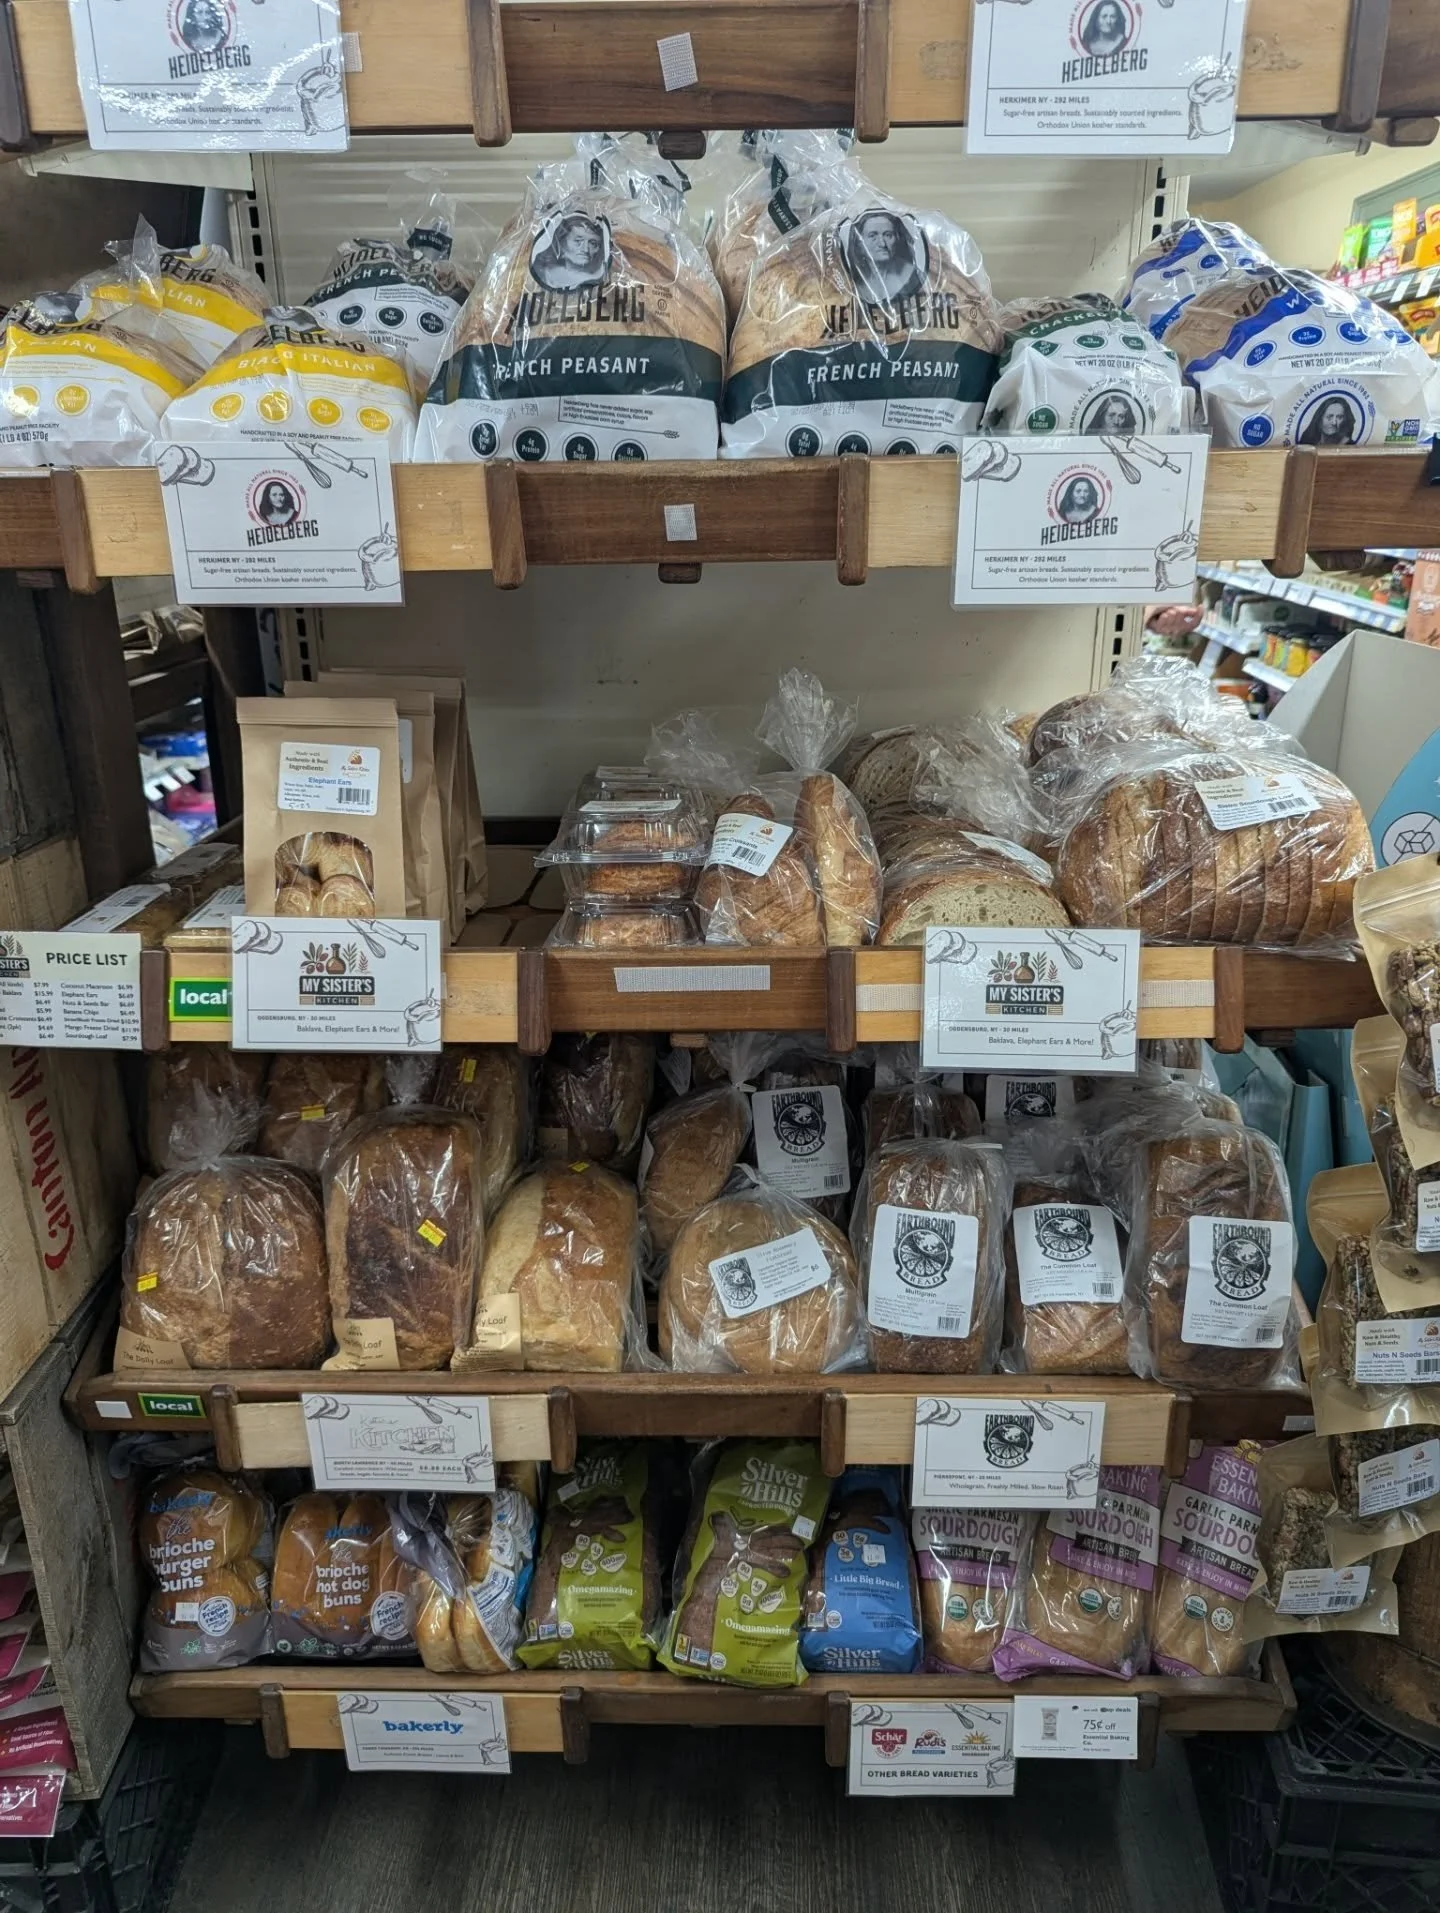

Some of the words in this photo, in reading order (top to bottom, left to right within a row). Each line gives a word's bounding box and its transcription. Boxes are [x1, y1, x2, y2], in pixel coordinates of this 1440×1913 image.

[1061, 48, 1148, 84] HEIDELBERG
[999, 96, 1036, 105] HERKIMER
[1037, 96, 1049, 105] NY
[1068, 96, 1090, 105] MILES
[1003, 109, 1036, 119] Sugar-free
[1036, 109, 1058, 118] artisan
[1083, 109, 1119, 119] Sustainably
[1119, 109, 1146, 118] sourced
[1037, 121, 1070, 130] Orthodox
[1070, 121, 1092, 130] Union
[1091, 121, 1114, 130] kosher
[1029, 309, 1109, 336] CRACKED
[303, 353, 376, 373] ITALIAN
[560, 356, 650, 375] PEASANT
[1075, 359, 1087, 368] NET
[1087, 359, 1098, 368] WT
[1098, 359, 1106, 369] 20
[1290, 360, 1305, 368] NET
[1305, 359, 1316, 367] WT
[1316, 358, 1325, 367] 20
[807, 362, 881, 385] FRENCH
[890, 360, 960, 379] PEASANT
[1069, 407, 1079, 430] MADE
[1077, 392, 1089, 408] ALL
[1285, 413, 1295, 435] MADE
[1293, 398, 1305, 412] ALL
[1304, 378, 1336, 399] NATURAL
[1337, 378, 1359, 388] SINCE
[1057, 464, 1081, 479] NATURAL
[247, 519, 319, 547] HEIDELBERG
[1040, 516, 1118, 546] HEIDELBERG
[984, 556, 1019, 564] HERKIMER
[1046, 555, 1067, 563] MILES
[272, 567, 302, 575] Sustainably
[987, 566, 1018, 575] Sugar-free
[1060, 566, 1092, 575] Sustainably
[234, 576, 263, 584] Orthodox
[263, 576, 281, 584] Union
[1018, 576, 1049, 584] Orthodox
[1049, 576, 1068, 584] Union
[288, 764, 325, 772] Ingredients
[308, 776, 337, 786] Elephant
[337, 778, 352, 786] Ears
[46, 952, 92, 966] PRICE
[96, 953, 128, 967] LIST
[302, 977, 320, 993] MY
[322, 978, 373, 994] SISTER'S
[179, 988, 228, 1006] local
[315, 996, 359, 1005] KITCHEN
[988, 986, 1008, 1002] MY
[1009, 986, 1062, 1003] SISTER'S
[1002, 1006, 1047, 1014] KITCHEN
[296, 1024, 324, 1034] Baklava,
[324, 1024, 355, 1035] Elephant
[355, 1025, 372, 1033] Ears
[372, 1025, 379, 1033] &
[379, 1025, 401, 1034] More!
[988, 1035, 1016, 1045] Baklava,
[1017, 1036, 1048, 1046] Elephant
[1048, 1036, 1065, 1045] Ears
[1065, 1037, 1072, 1046] &
[1072, 1037, 1095, 1046] More!
[1005, 1080, 1057, 1103] EARTHBOUND
[770, 1089, 825, 1118] EARTHBOUND
[786, 1140, 820, 1153] BREAD
[25, 1097, 75, 1271] Canton
[896, 1212, 957, 1242] EARTHBOUND
[1033, 1207, 1091, 1232] EARTHBOUND
[1212, 1222, 1273, 1252] EARTHBOUND
[1049, 1249, 1087, 1261] BREAD
[1052, 1262, 1082, 1270] Common
[1082, 1262, 1097, 1270] Loaf
[902, 1271, 943, 1287] BREAD
[904, 1286, 938, 1299] Multigrain
[1221, 1283, 1261, 1298] BREAD
[1208, 1299, 1222, 1307] The
[1222, 1301, 1252, 1310] Common
[1253, 1303, 1268, 1311] Loaf
[487, 1315, 508, 1326] Loaf
[363, 1339, 383, 1350] Loaf
[122, 1351, 135, 1361] The
[135, 1353, 154, 1366] Daily
[1399, 1351, 1422, 1359] Seeds
[1423, 1350, 1440, 1358] Bars
[149, 1400, 193, 1412] local
[985, 1413, 1035, 1434] EARTHBOUND
[991, 1455, 1024, 1467] BREAD
[742, 1456, 809, 1490] Silver
[754, 1482, 803, 1509] Hills
[1217, 1477, 1263, 1509] BAKIN
[967, 1507, 1019, 1525] PARMESAN
[1184, 1495, 1226, 1522] GARLIC
[165, 1515, 193, 1540] the
[919, 1516, 1022, 1548] SOURDOUGH
[1172, 1507, 1261, 1562] SOURDO
[150, 1536, 216, 1560] brioche
[1083, 1537, 1116, 1555] ARTISAN
[939, 1547, 974, 1559] ARTISAN
[976, 1550, 1001, 1561] BREAD
[1190, 1544, 1229, 1569] ARTISAN
[1229, 1560, 1257, 1580] BREAD
[316, 1563, 370, 1578] brioche
[834, 1573, 858, 1584] Little
[859, 1575, 875, 1586] Big
[875, 1576, 901, 1590] Bread
[1200, 1568, 1225, 1586] ENJOY
[1225, 1577, 1235, 1589] IN
[315, 1578, 338, 1593] hot
[341, 1577, 370, 1597] dog
[567, 1584, 634, 1597] Omegamazing
[323, 1592, 362, 1609] buns
[202, 1602, 229, 1619] French
[376, 1601, 405, 1617] French
[204, 1610, 230, 1624] recipe
[725, 1617, 791, 1636] Omegamazing
[557, 1649, 611, 1665] Silver
[822, 1648, 881, 1660] Silver
[836, 1656, 881, 1668] Hills
[383, 1720, 464, 1735] bakerly
[1082, 1719, 1104, 1730] 75¢
[1104, 1723, 1116, 1731] off
[914, 1736, 947, 1749] Rudi's
[1109, 1734, 1130, 1742] Baking
[867, 1770, 898, 1778] OTHER
[899, 1770, 930, 1778] BREAD
[932, 1770, 979, 1779] VARIETIES
